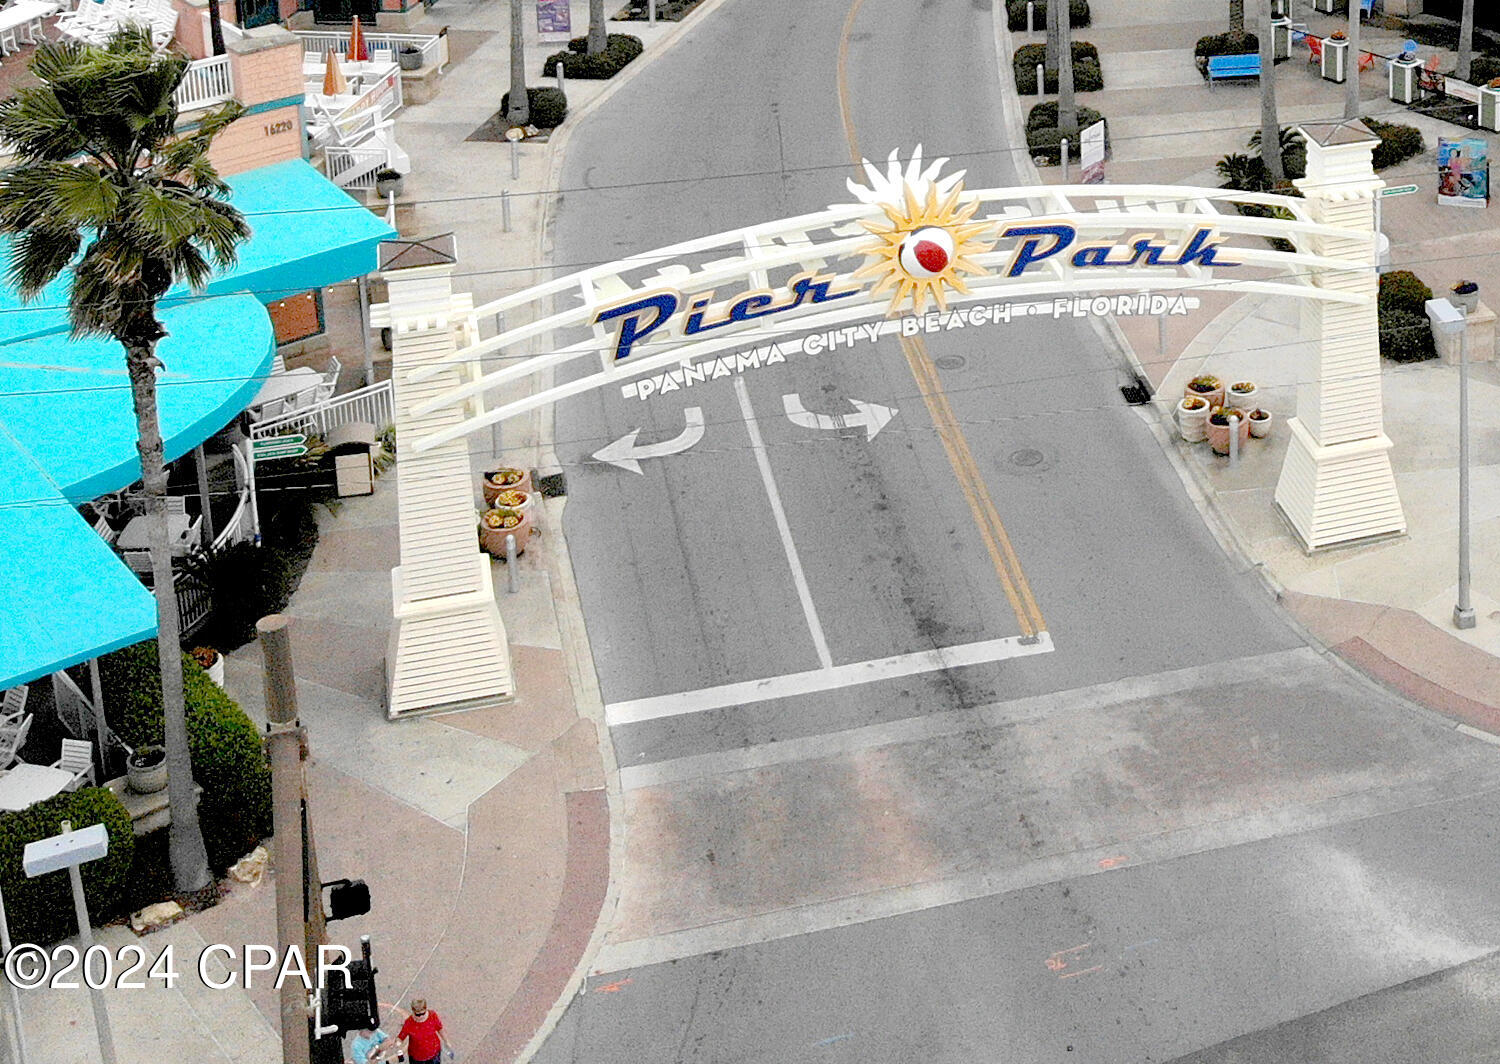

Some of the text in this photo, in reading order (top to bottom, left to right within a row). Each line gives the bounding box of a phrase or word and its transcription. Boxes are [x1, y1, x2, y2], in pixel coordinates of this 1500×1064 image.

[585, 219, 1246, 365] Pier Park
[634, 294, 1189, 402] PANAMA CITY BEACH FLORIDA
